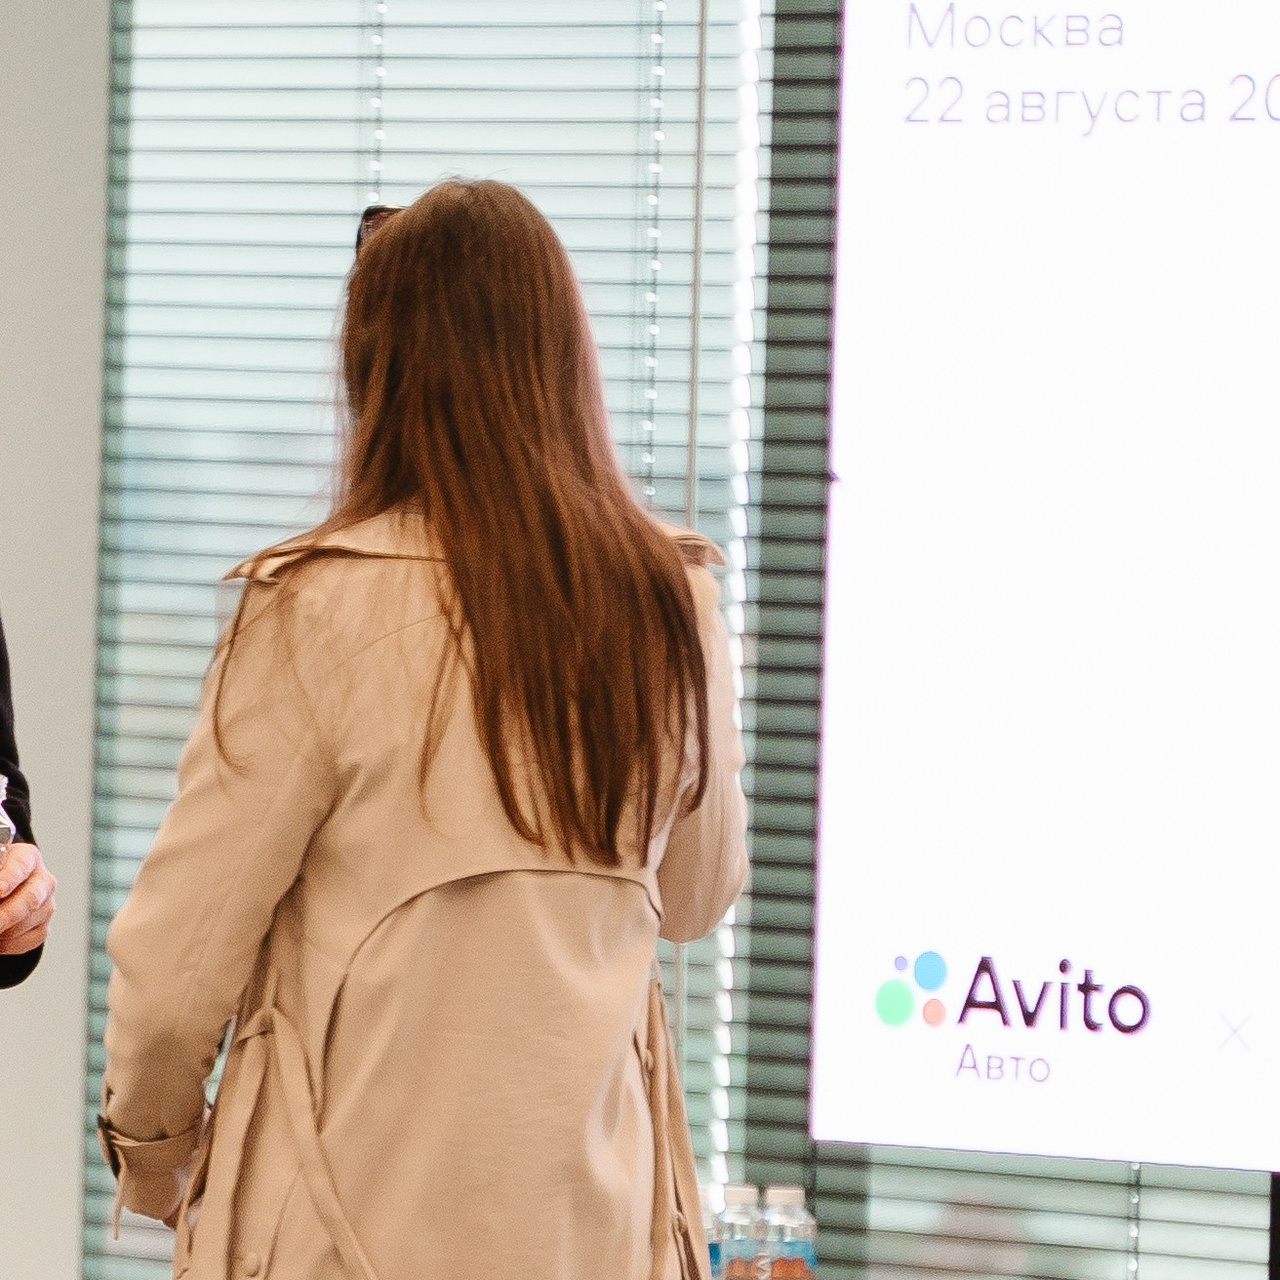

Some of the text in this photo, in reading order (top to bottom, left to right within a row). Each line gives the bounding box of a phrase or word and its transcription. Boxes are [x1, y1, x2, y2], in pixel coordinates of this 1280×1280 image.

[907, 1, 1125, 48] Москва
[904, 76, 964, 123] 22
[985, 89, 1207, 137] августа
[957, 956, 1151, 1036] Avito
[955, 1043, 1051, 1083] Авто
